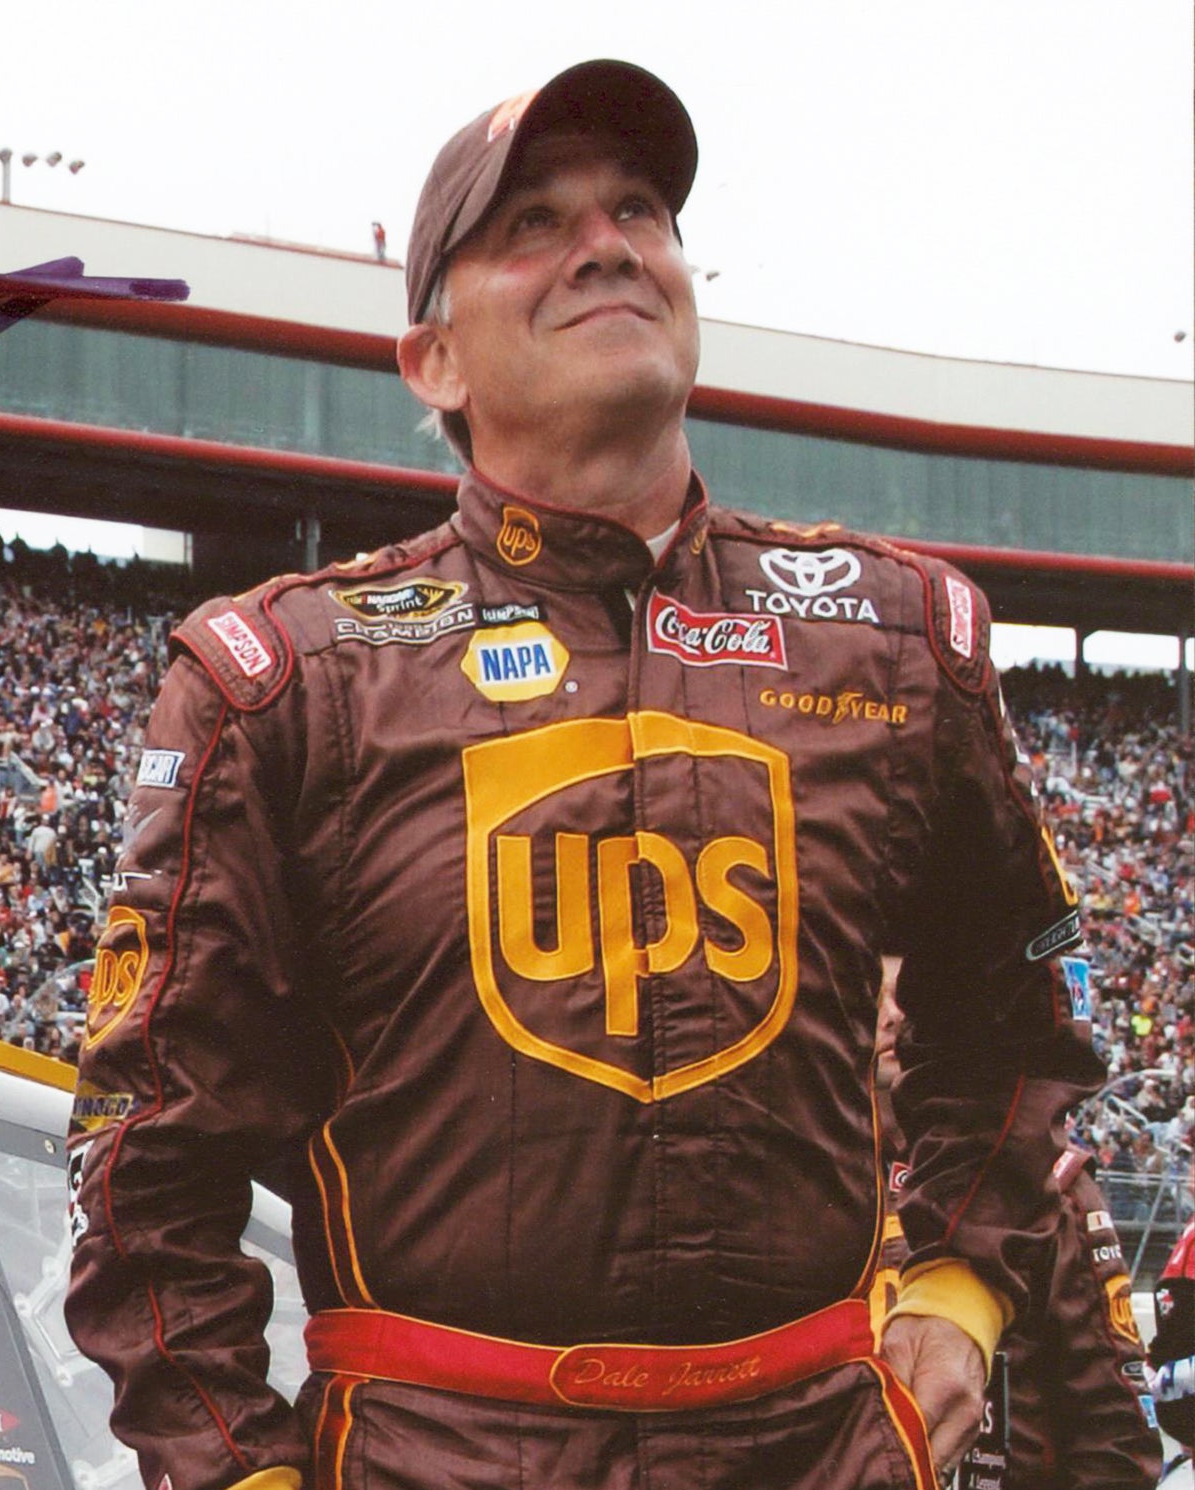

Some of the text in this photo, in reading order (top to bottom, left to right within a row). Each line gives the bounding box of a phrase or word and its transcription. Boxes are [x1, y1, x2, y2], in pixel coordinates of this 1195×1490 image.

[503, 524, 536, 557] ups
[376, 597, 424, 614] Sprint
[745, 590, 880, 623] TOYOTA
[218, 614, 267, 675] SIMPSON
[654, 605, 773, 656] Coca-Cola
[480, 643, 551, 682] NAPA
[759, 689, 909, 724] GOODYEAR
[497, 831, 774, 1036] ups
[573, 1357, 649, 1389] Dale
